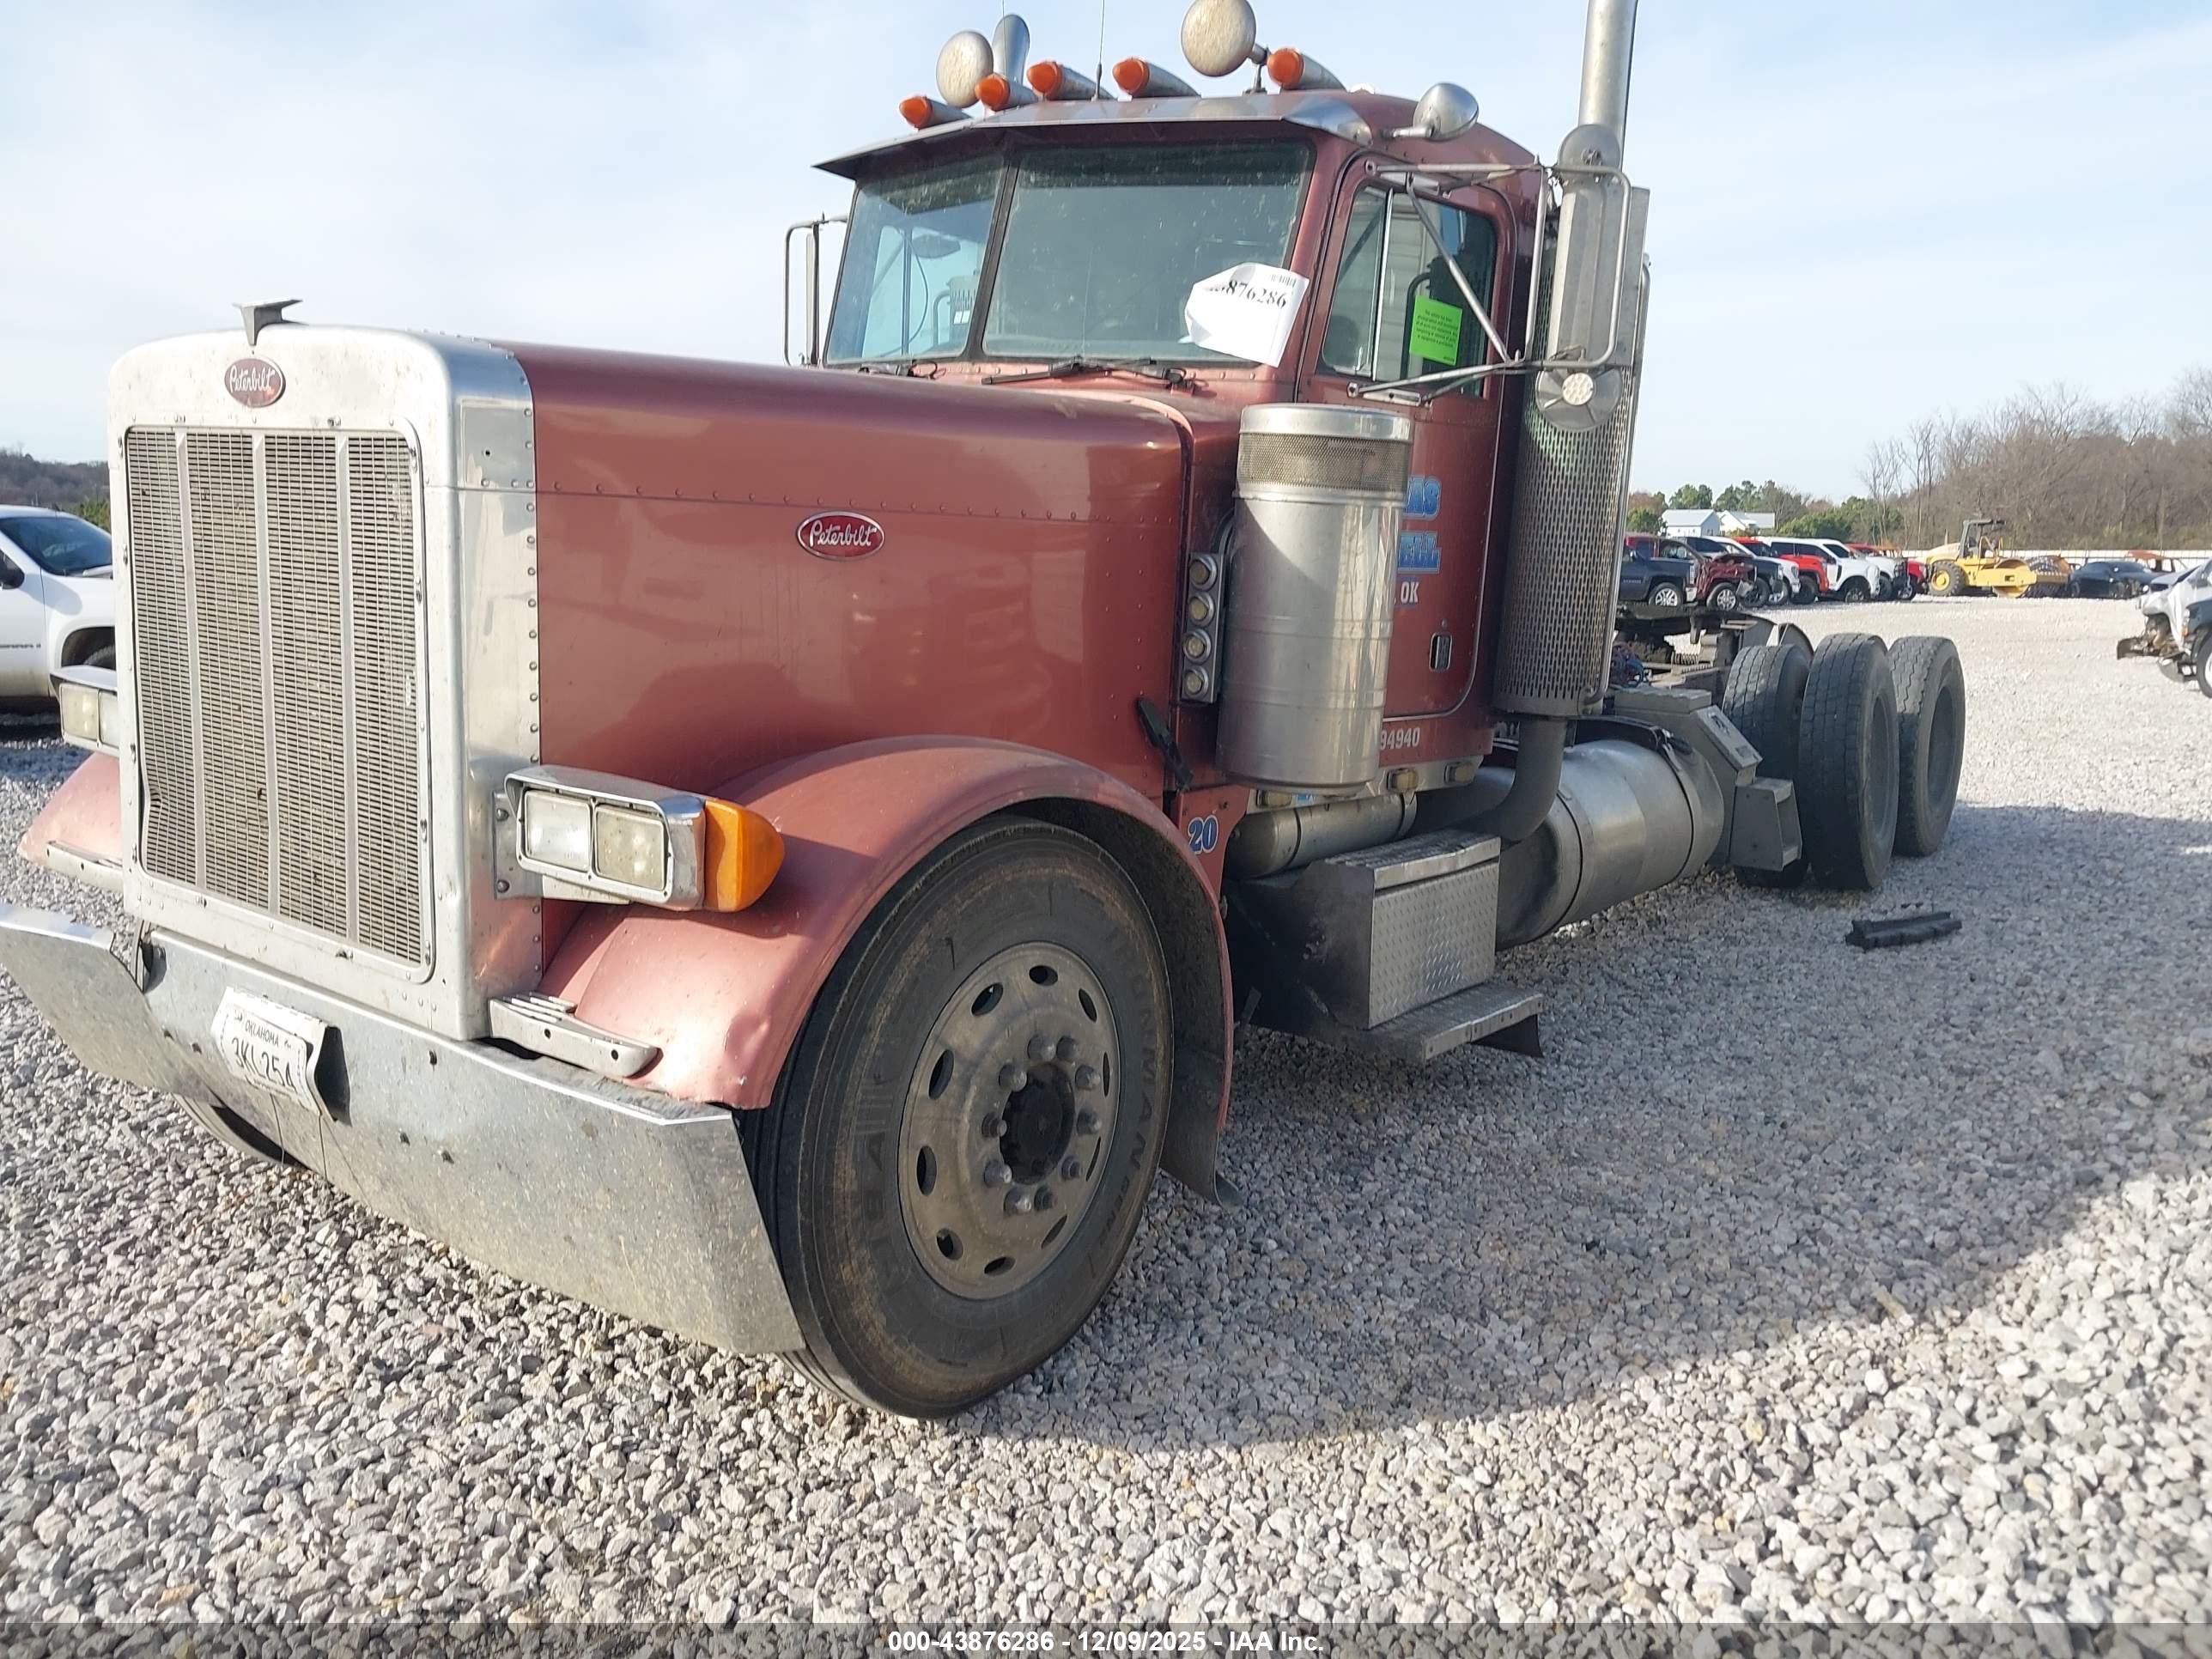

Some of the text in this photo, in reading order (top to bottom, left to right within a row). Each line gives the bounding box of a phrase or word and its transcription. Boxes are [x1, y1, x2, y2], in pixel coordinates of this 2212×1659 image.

[1208, 279, 1287, 310] 876286
[229, 364, 276, 393] Peterbilt
[808, 520, 878, 547] Peterbilt
[1400, 580, 1419, 605] OK
[1187, 814, 1219, 855] 20
[245, 1019, 280, 1048] OKLAHOMA
